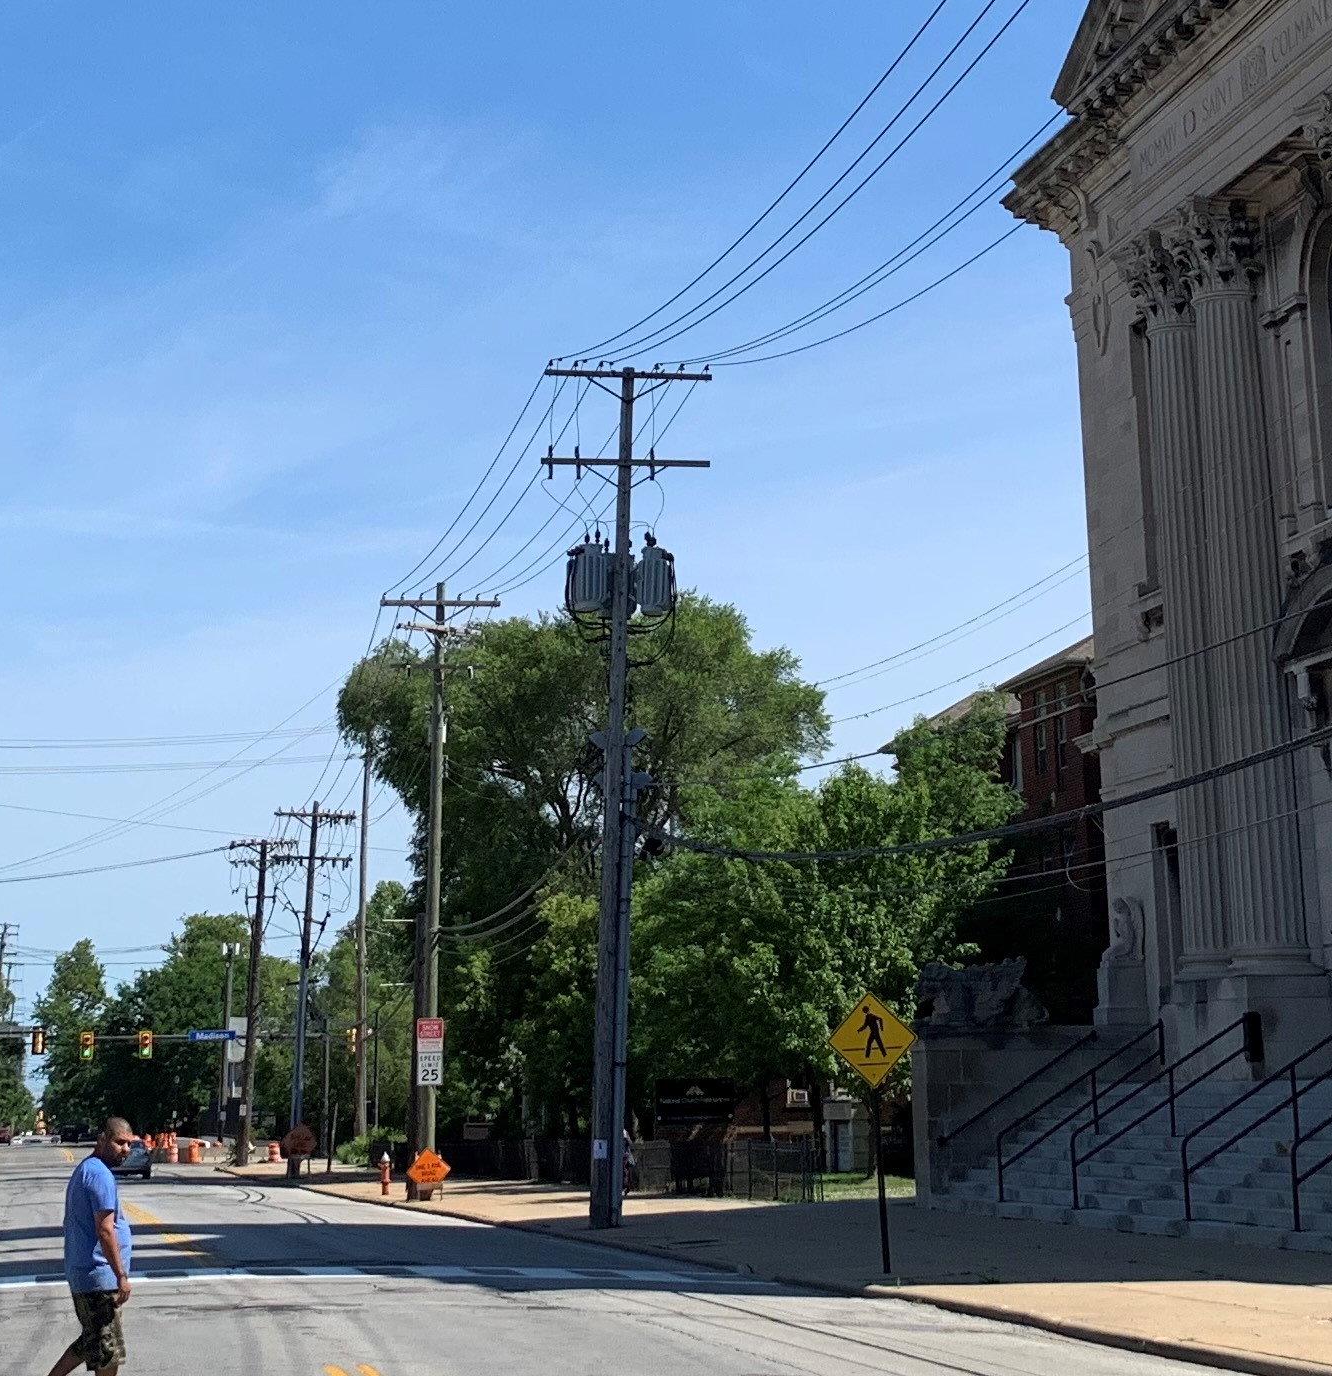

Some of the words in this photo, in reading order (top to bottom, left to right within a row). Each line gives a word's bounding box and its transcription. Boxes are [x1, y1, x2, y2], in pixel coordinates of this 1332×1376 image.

[1202, 75, 1236, 122] SAINT
[1271, 2, 1323, 63] COLMAN
[195, 1032, 230, 1040] Madison
[421, 1069, 439, 1081] 25
